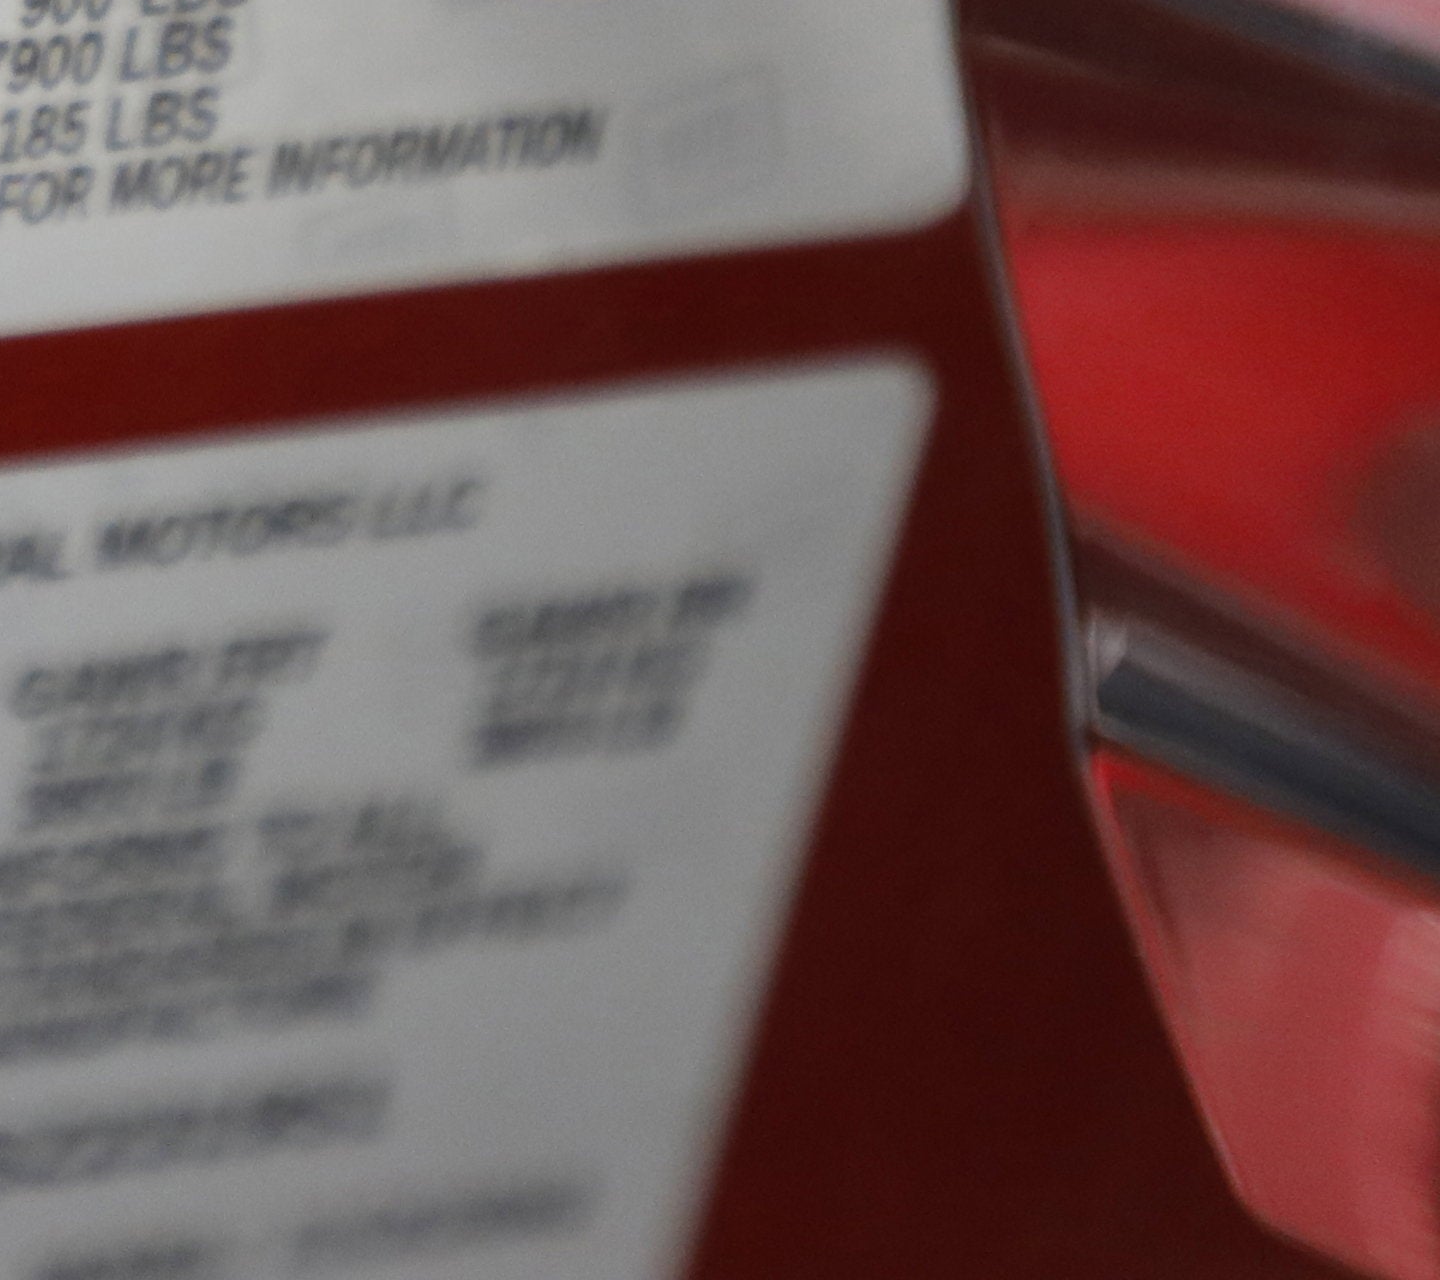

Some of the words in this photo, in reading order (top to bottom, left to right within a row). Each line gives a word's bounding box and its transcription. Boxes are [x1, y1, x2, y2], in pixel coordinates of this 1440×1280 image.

[112, 8, 235, 85] LBS
[101, 82, 221, 153] LBS
[106, 141, 256, 211] MORE
[263, 102, 607, 197] INFORMATION
[94, 491, 360, 567] MOTORS
